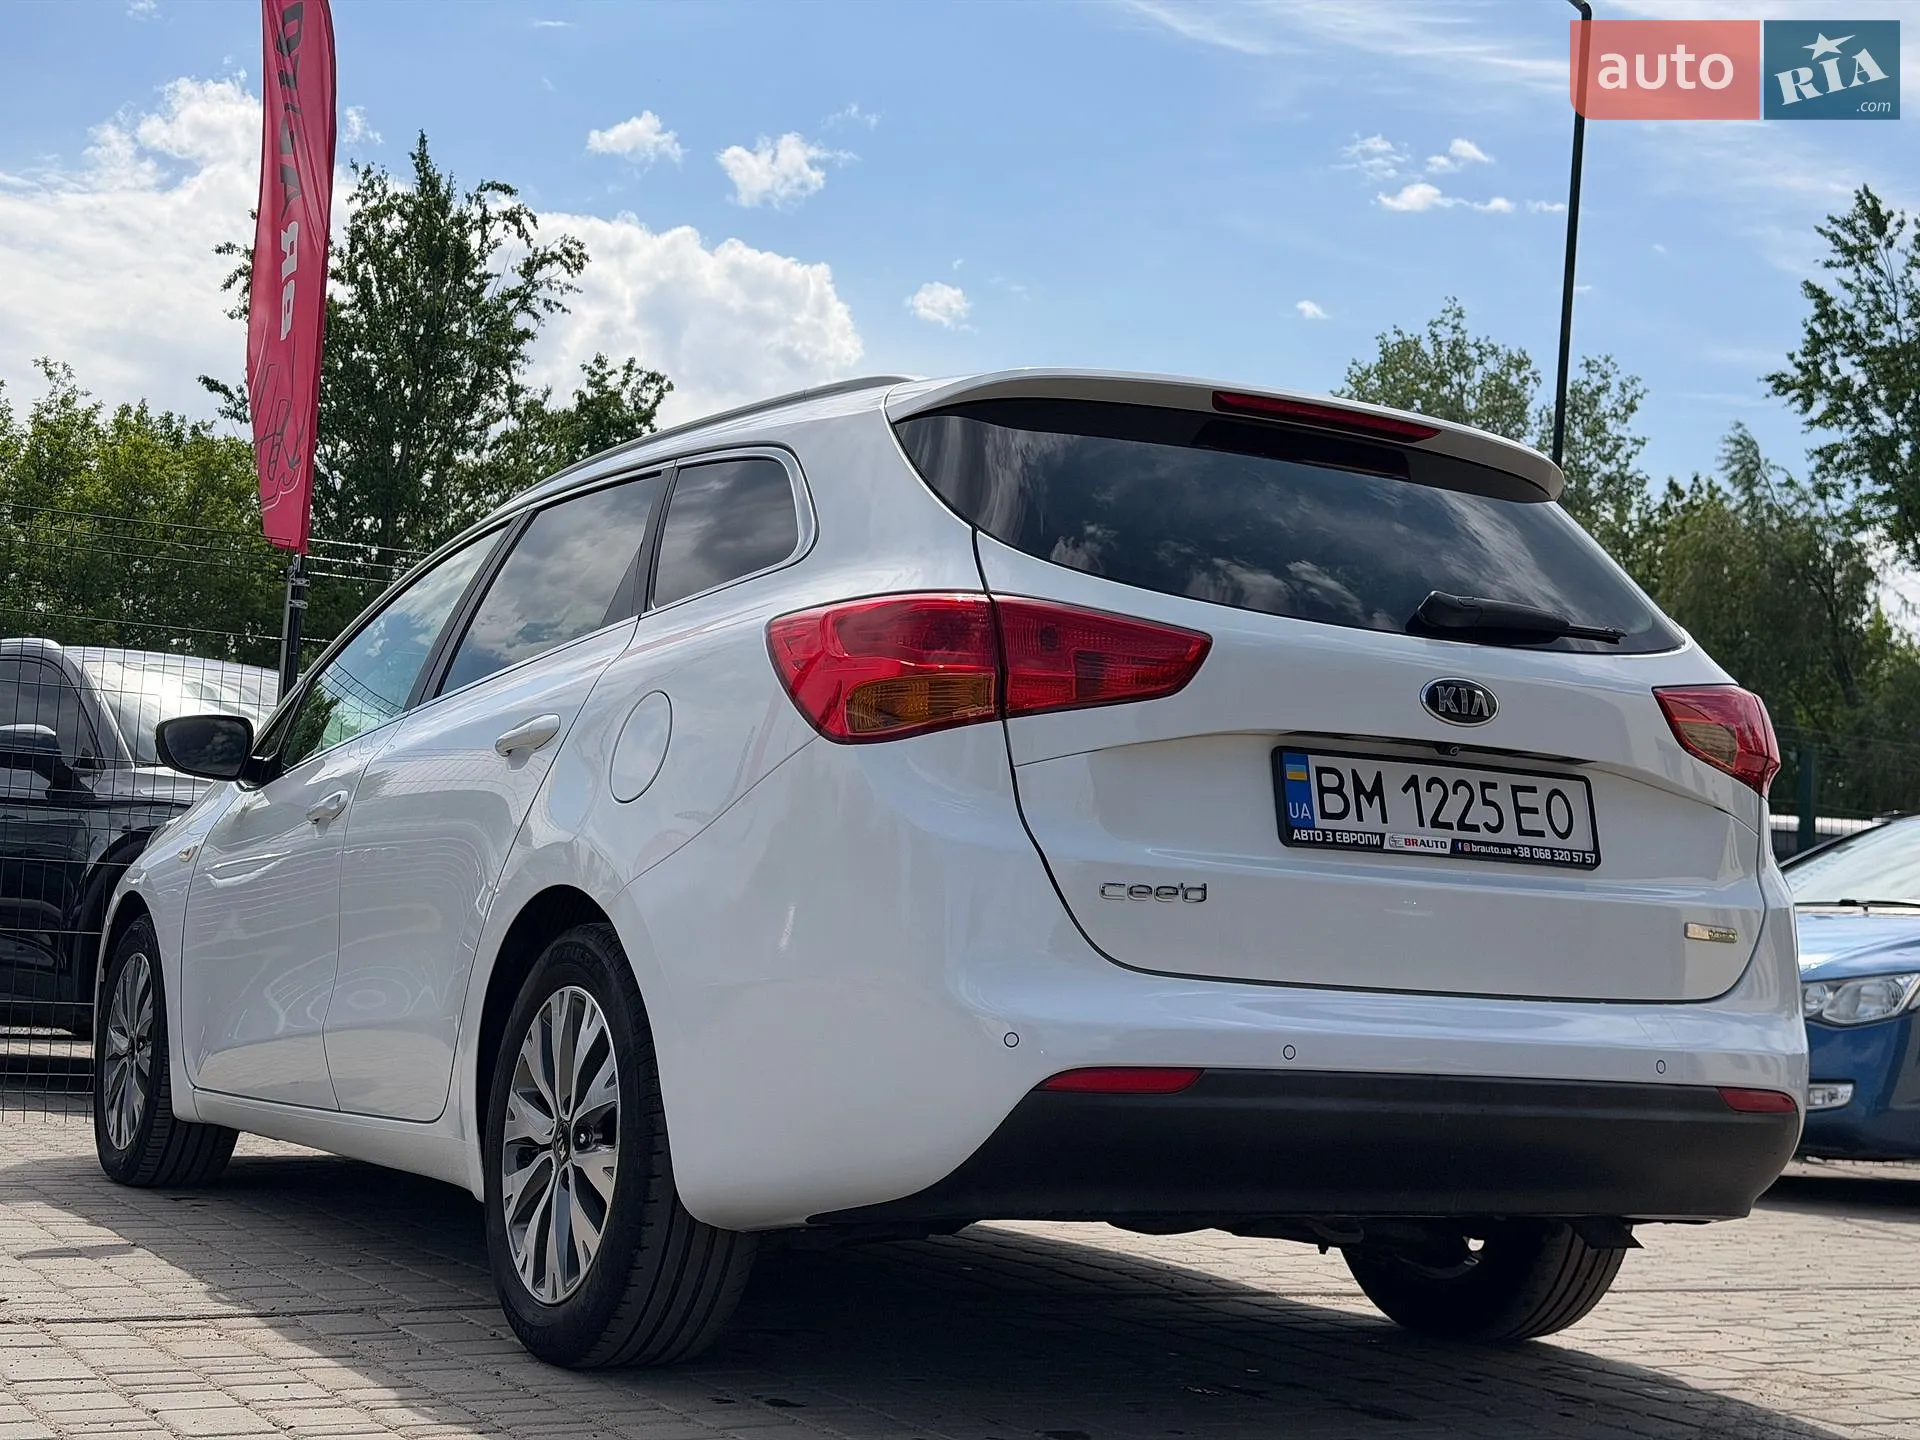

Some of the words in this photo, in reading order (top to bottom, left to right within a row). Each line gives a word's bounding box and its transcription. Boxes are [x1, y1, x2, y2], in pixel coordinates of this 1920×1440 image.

[1436, 686, 1489, 717] KIA
[1289, 801, 1312, 821] UA
[1315, 765, 1389, 825] BM
[1401, 774, 1505, 834] 1225
[1510, 784, 1574, 840] EO
[1293, 829, 1323, 843] АВТО
[1336, 832, 1381, 846] ЕВРОПИ
[1404, 838, 1448, 850] BRAUTO
[1471, 843, 1512, 855] brauto.ua
[1513, 846, 1531, 858] +38
[1532, 849, 1552, 860] 068
[1553, 850, 1571, 862] 320
[1572, 852, 1583, 863] 57
[1585, 853, 1596, 864] 57
